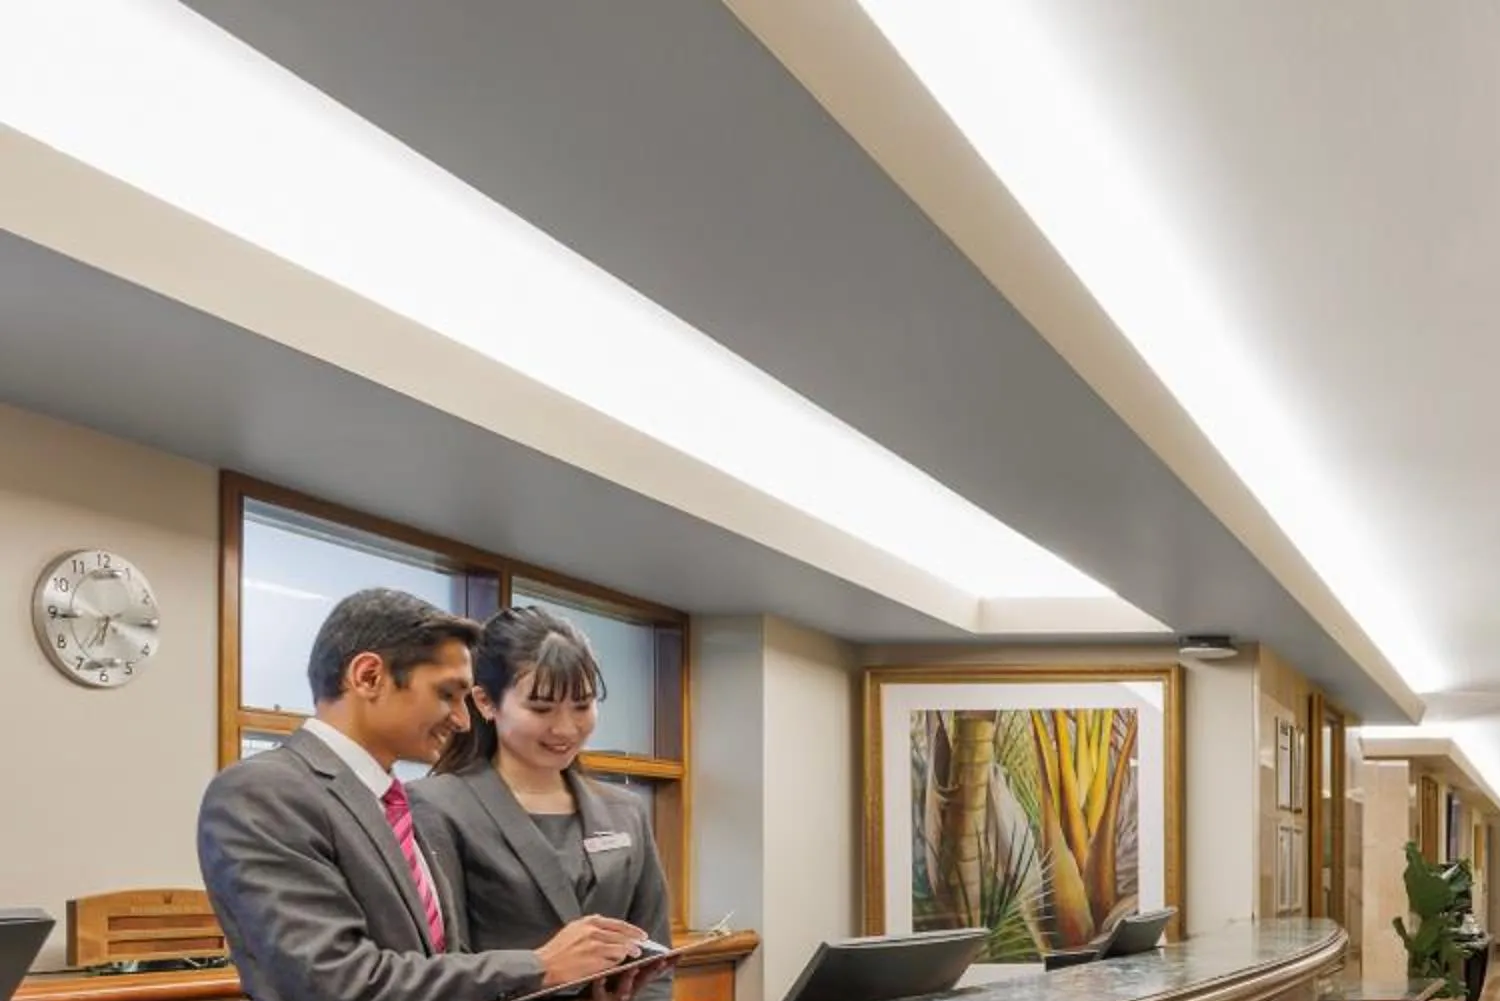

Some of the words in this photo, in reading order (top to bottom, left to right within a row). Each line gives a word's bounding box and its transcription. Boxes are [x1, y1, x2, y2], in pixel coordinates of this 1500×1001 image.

[72, 560, 85, 574] 11
[97, 554, 110, 568] 12
[125, 568, 132, 580] 1
[54, 577, 69, 592] 10
[141, 589, 150, 605] 2
[48, 606, 58, 619] 9
[57, 634, 67, 649] 8
[141, 643, 150, 656] 4
[76, 656, 84, 670] 7
[125, 662, 135, 675] 5
[100, 670, 109, 682] 6
